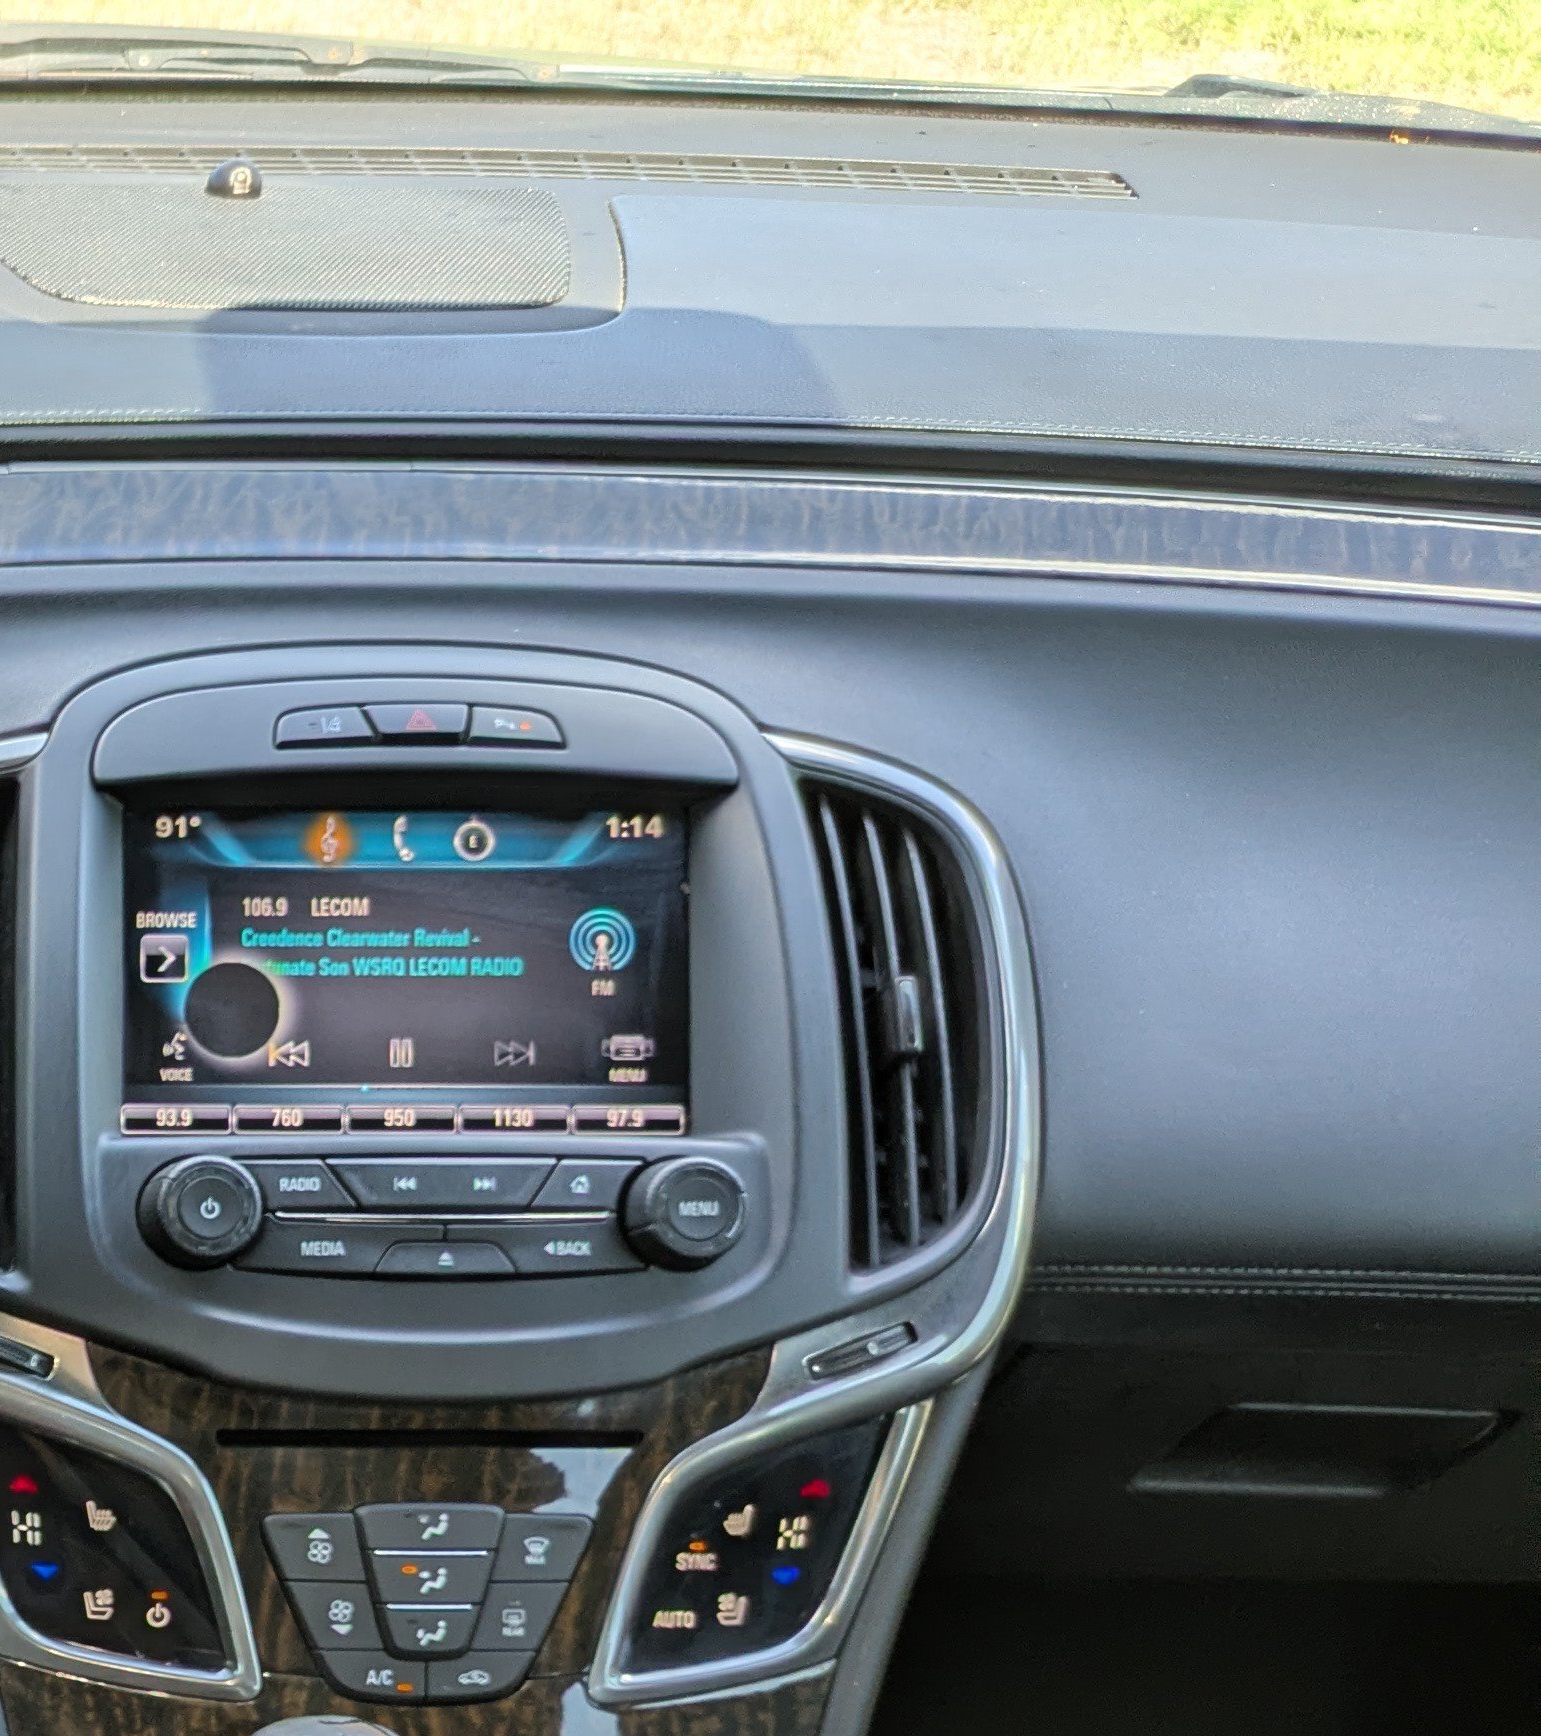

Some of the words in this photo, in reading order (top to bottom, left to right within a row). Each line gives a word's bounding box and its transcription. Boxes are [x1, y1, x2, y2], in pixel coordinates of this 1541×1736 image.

[605, 814, 665, 839] 1:14
[242, 896, 289, 917] 106.9
[310, 897, 370, 917] LECOM
[135, 911, 198, 929] BROWSE
[241, 927, 324, 947] Creedence
[326, 928, 411, 948] Clearwater
[413, 928, 471, 948] Revival
[318, 956, 350, 977] Son
[408, 957, 467, 977] LECOM
[469, 957, 525, 977] RADIO
[591, 978, 616, 997] FM
[155, 1107, 194, 1128] 93.9
[270, 1107, 303, 1128] 760
[383, 1107, 415, 1128] 950
[493, 1107, 535, 1128] 1130
[606, 1107, 647, 1128] 97.9
[279, 1177, 321, 1192] RADIO
[678, 1201, 719, 1217] MENU
[300, 1241, 346, 1257] MEDIA
[675, 1551, 718, 1572] SYNC
[652, 1610, 697, 1629] AUTO
[366, 1668, 394, 1687] A/C
